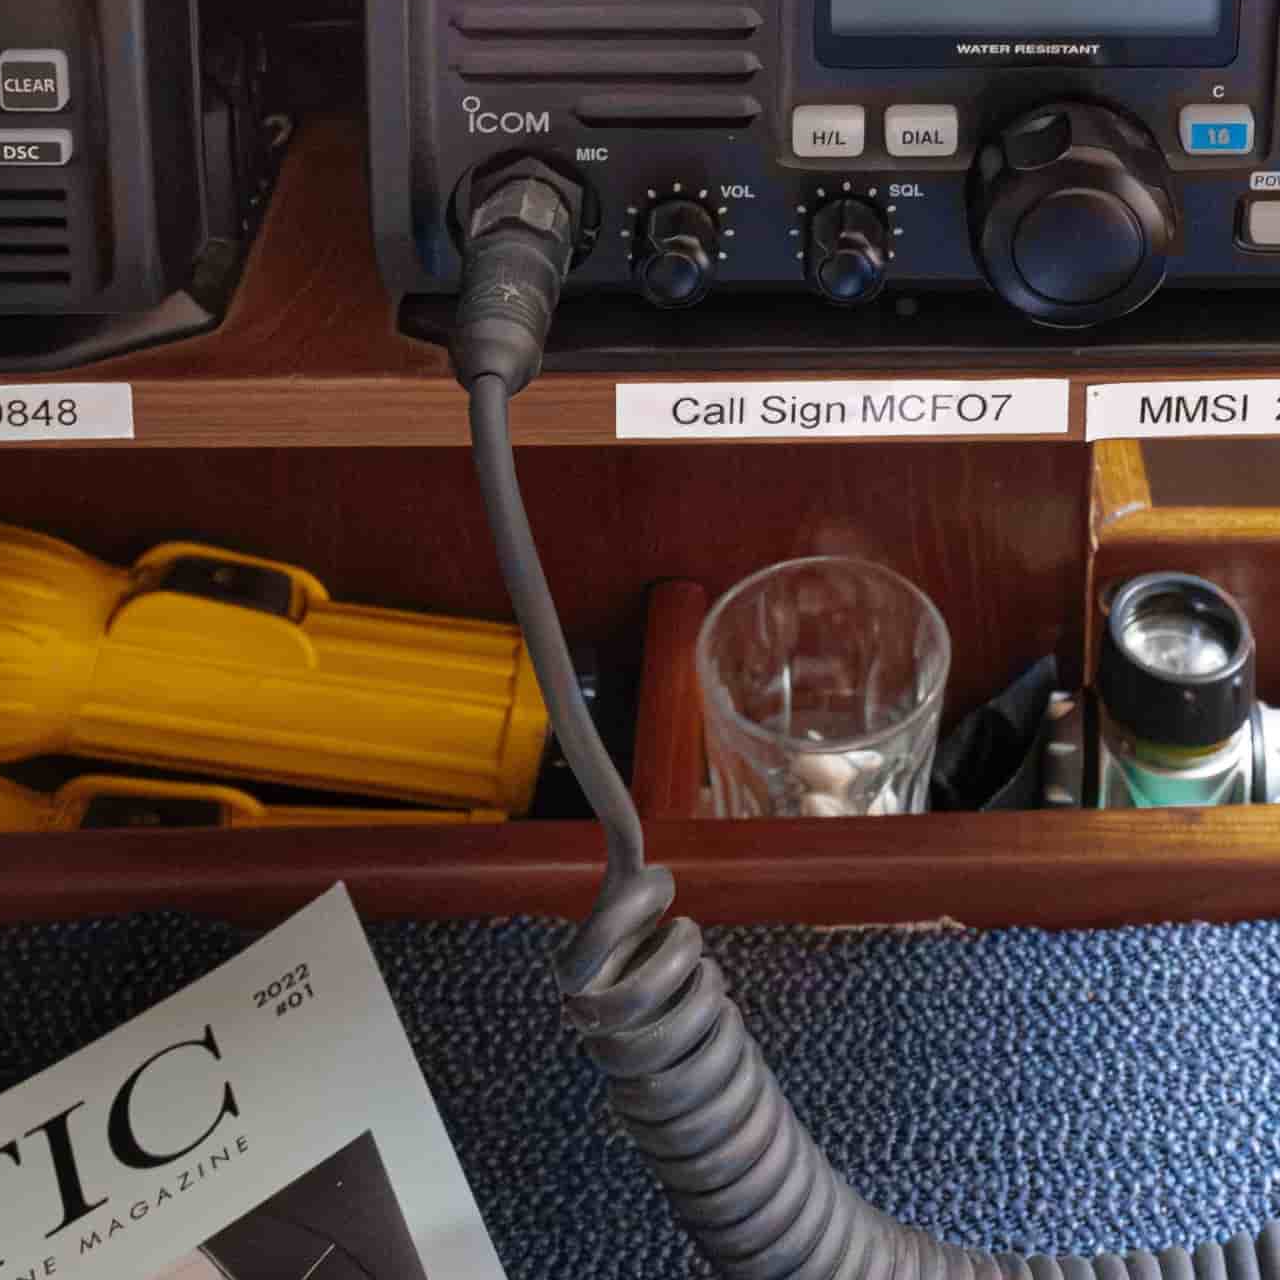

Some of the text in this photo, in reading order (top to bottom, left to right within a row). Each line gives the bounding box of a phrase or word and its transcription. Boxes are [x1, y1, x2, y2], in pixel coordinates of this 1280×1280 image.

[957, 44, 1100, 56] WATER RESISTANT
[4, 78, 56, 94] CLEAR
[1212, 85, 1225, 98] C
[812, 130, 847, 147] H/L
[901, 129, 944, 145] DIAL
[2, 145, 40, 160] DSC
[576, 148, 609, 162] MIC
[721, 185, 755, 199] VOL
[889, 184, 924, 198] SQL
[671, 392, 1013, 429] Call Sign MCFO7
[1138, 393, 1250, 425] MMSI
[253, 963, 310, 1009] 2022
[79, 1134, 251, 1256] MAGAZINE
